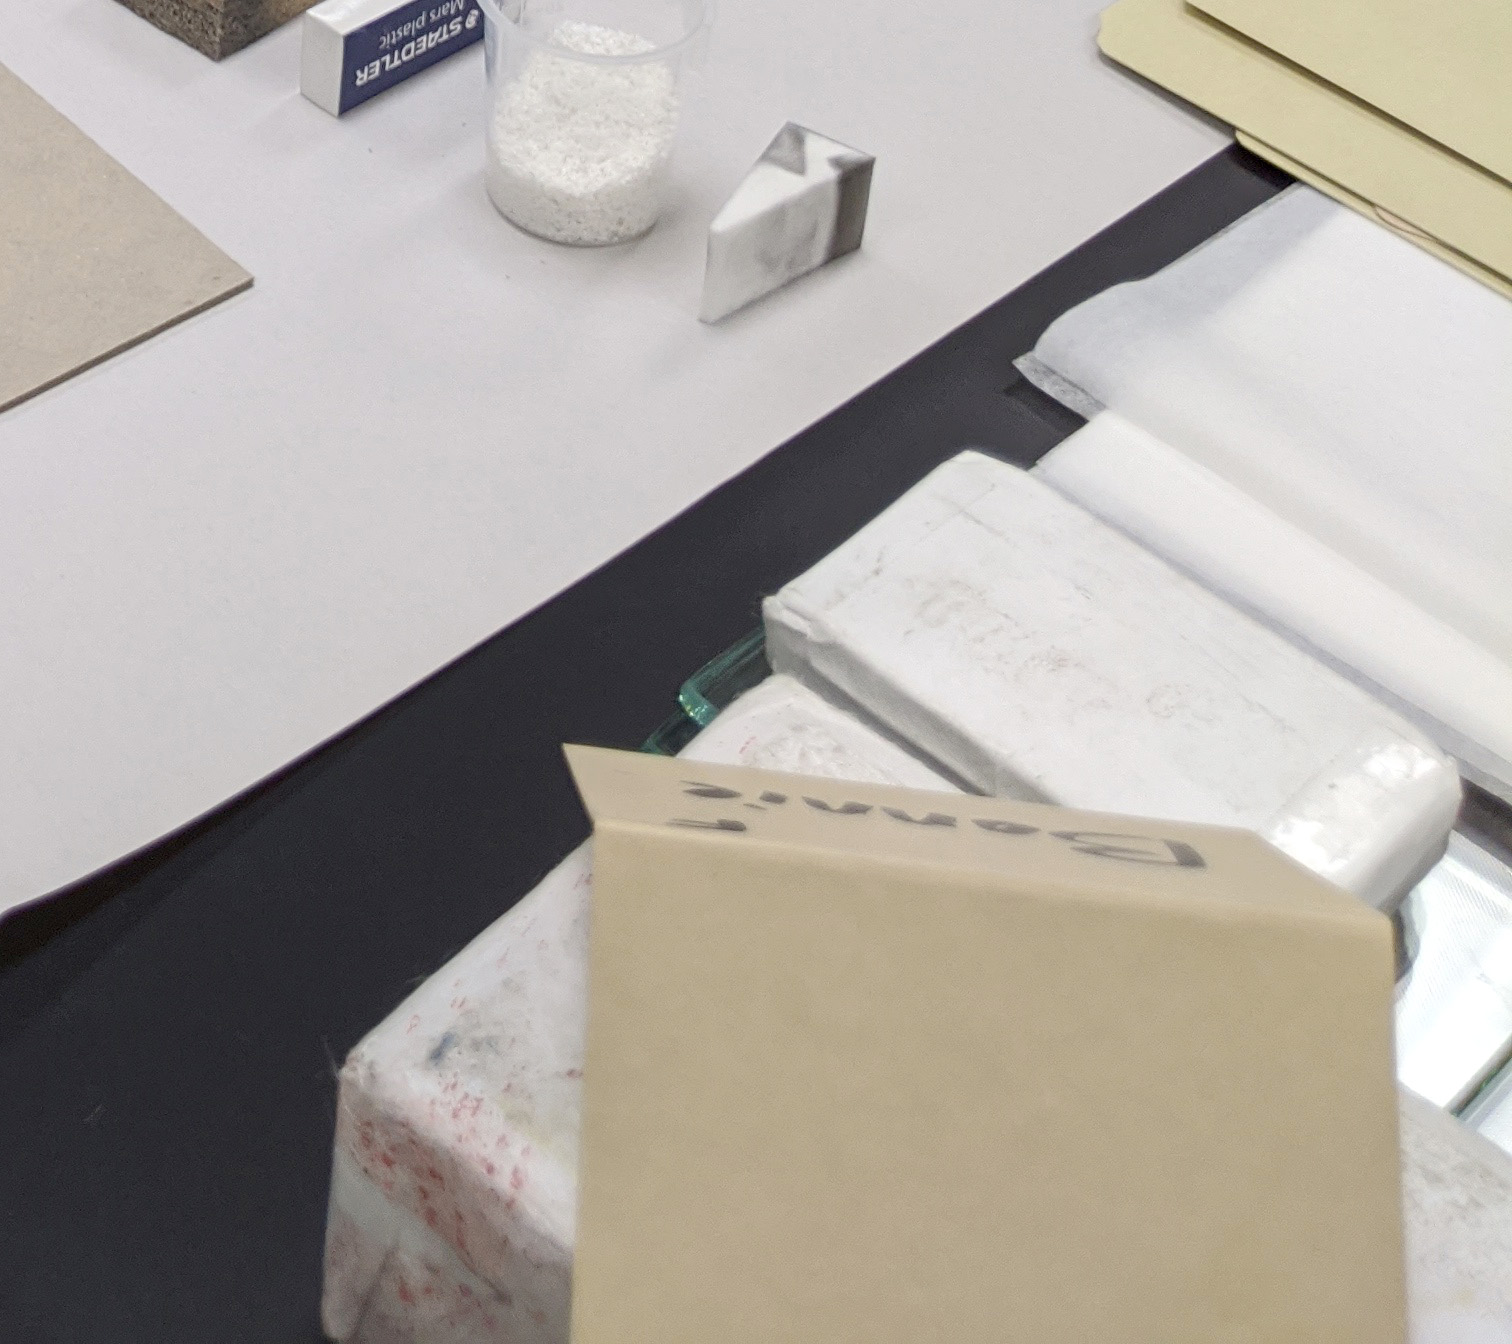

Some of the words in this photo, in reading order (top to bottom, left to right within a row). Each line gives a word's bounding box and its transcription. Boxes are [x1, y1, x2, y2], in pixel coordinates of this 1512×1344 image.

[355, 16, 463, 86] STAEDTLER
[379, 12, 426, 50] plastic
[679, 780, 1207, 870] Bonnie
